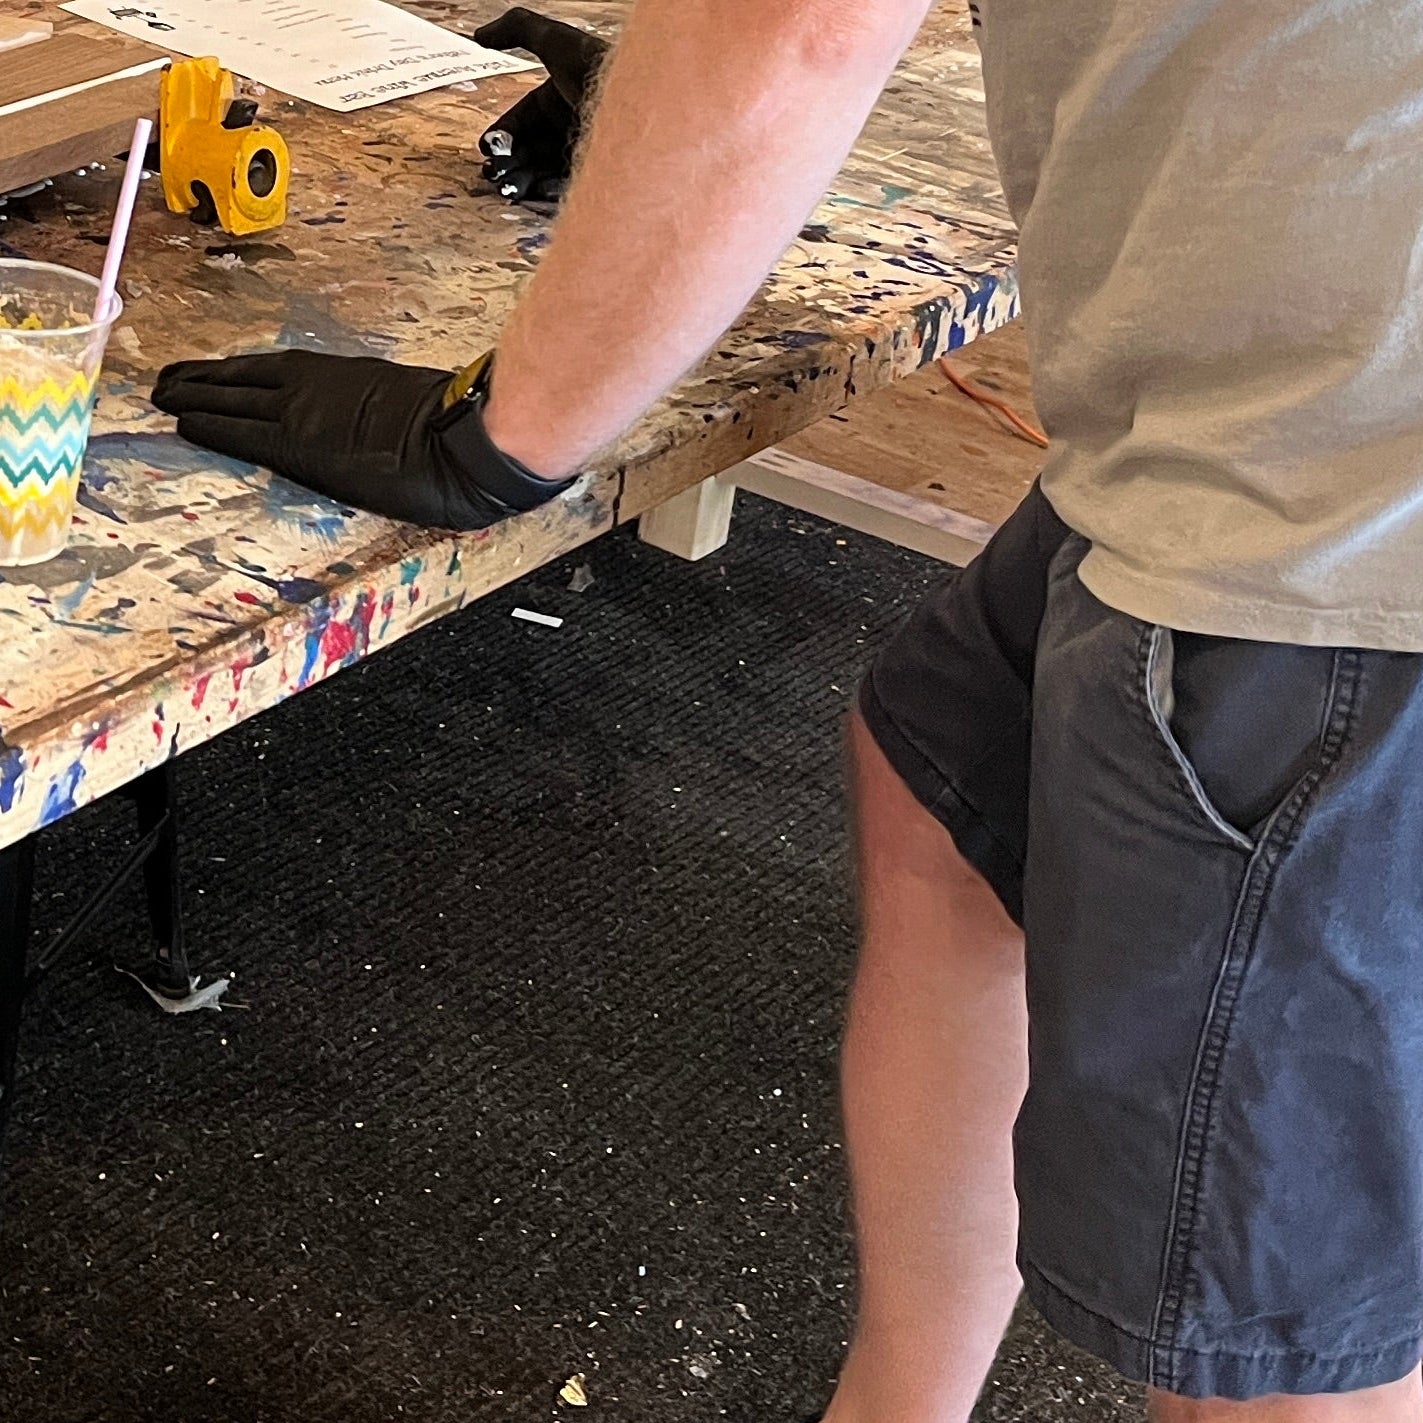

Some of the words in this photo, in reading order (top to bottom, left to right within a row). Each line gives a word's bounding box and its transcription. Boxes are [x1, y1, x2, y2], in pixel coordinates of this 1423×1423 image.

[389, 55, 422, 68] Day
[314, 71, 354, 87] Menu
[371, 79, 419, 94] Wine
